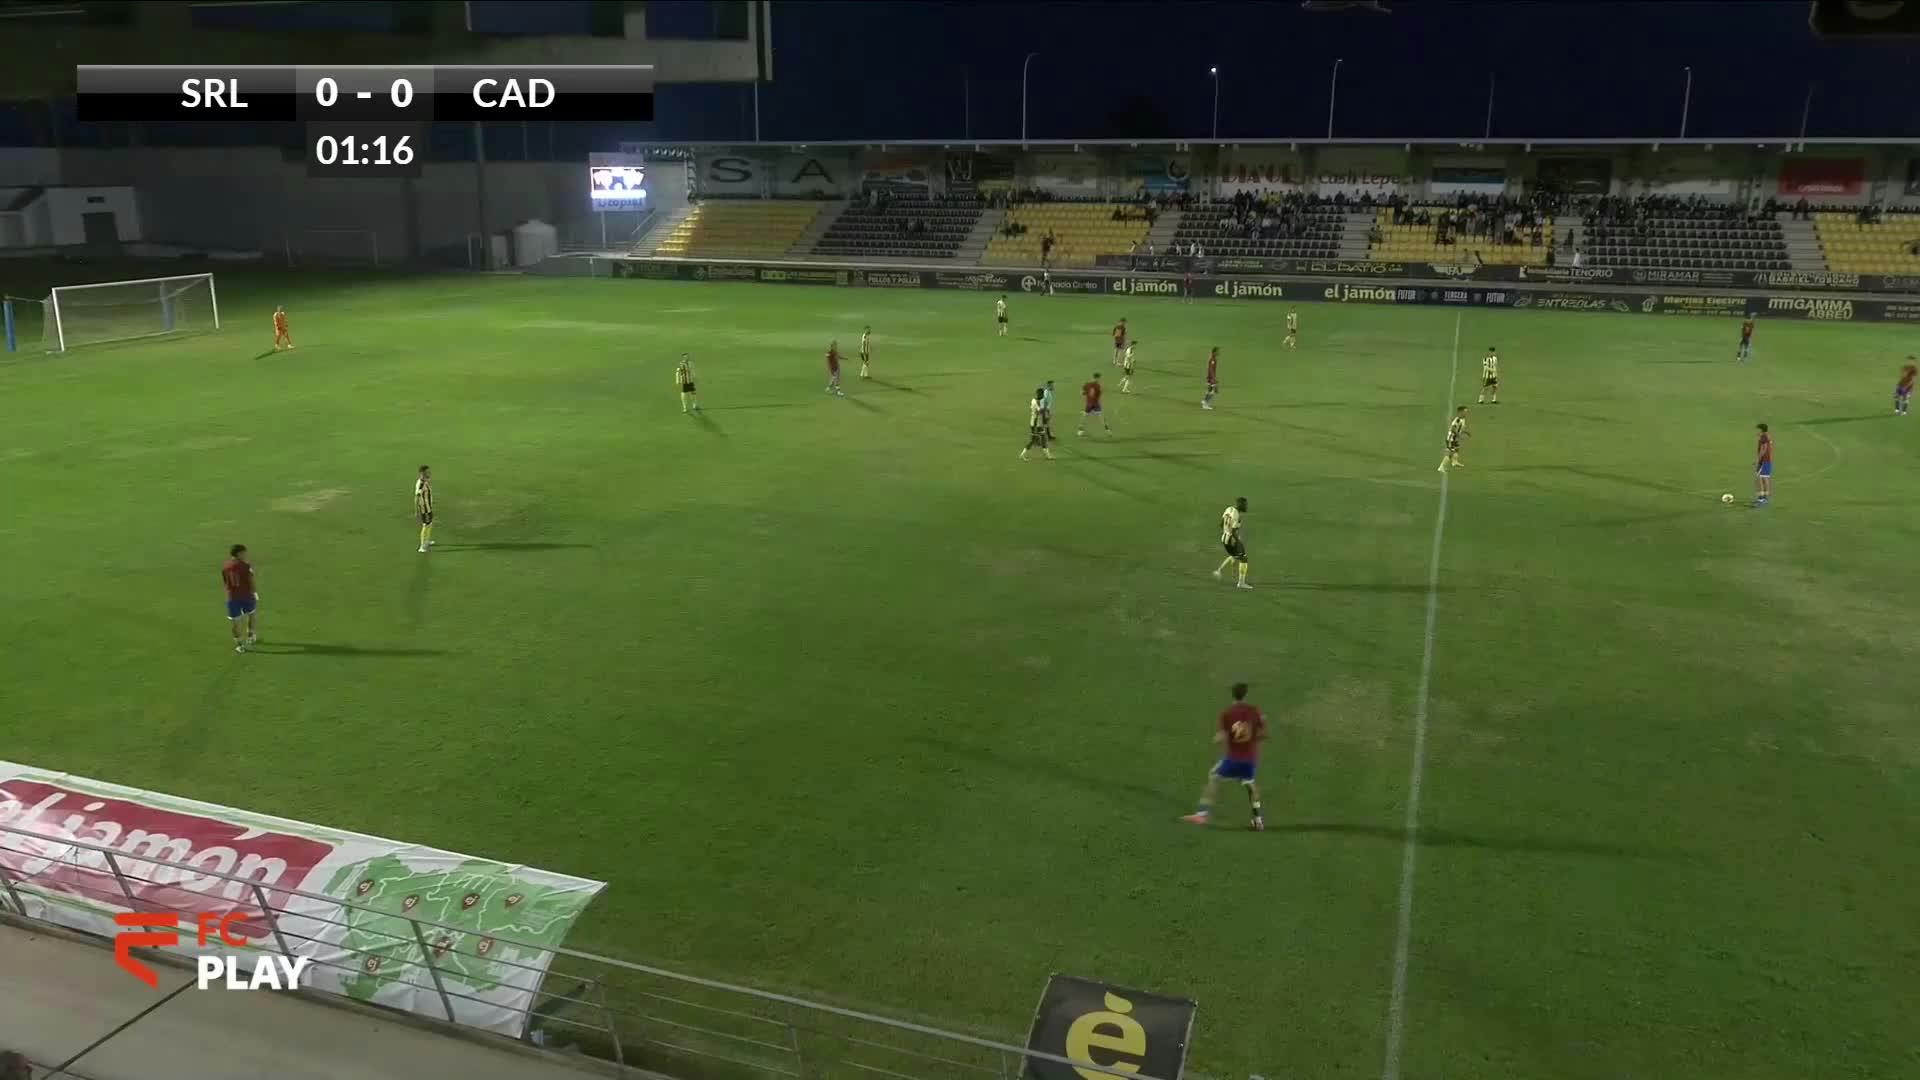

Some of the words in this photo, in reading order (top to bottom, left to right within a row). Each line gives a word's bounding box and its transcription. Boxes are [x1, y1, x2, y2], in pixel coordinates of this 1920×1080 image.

[791, 159, 834, 184] A
[1648, 270, 1700, 281] MIRAMAR
[1113, 278, 1126, 292] el
[1129, 278, 1178, 295] jamón
[1215, 280, 1229, 295] el
[1231, 281, 1282, 298] jamón
[1324, 284, 1339, 299] el
[1342, 284, 1395, 302] jamón
[1794, 298, 1853, 311] GAMMA
[22, 801, 288, 899] jamón
